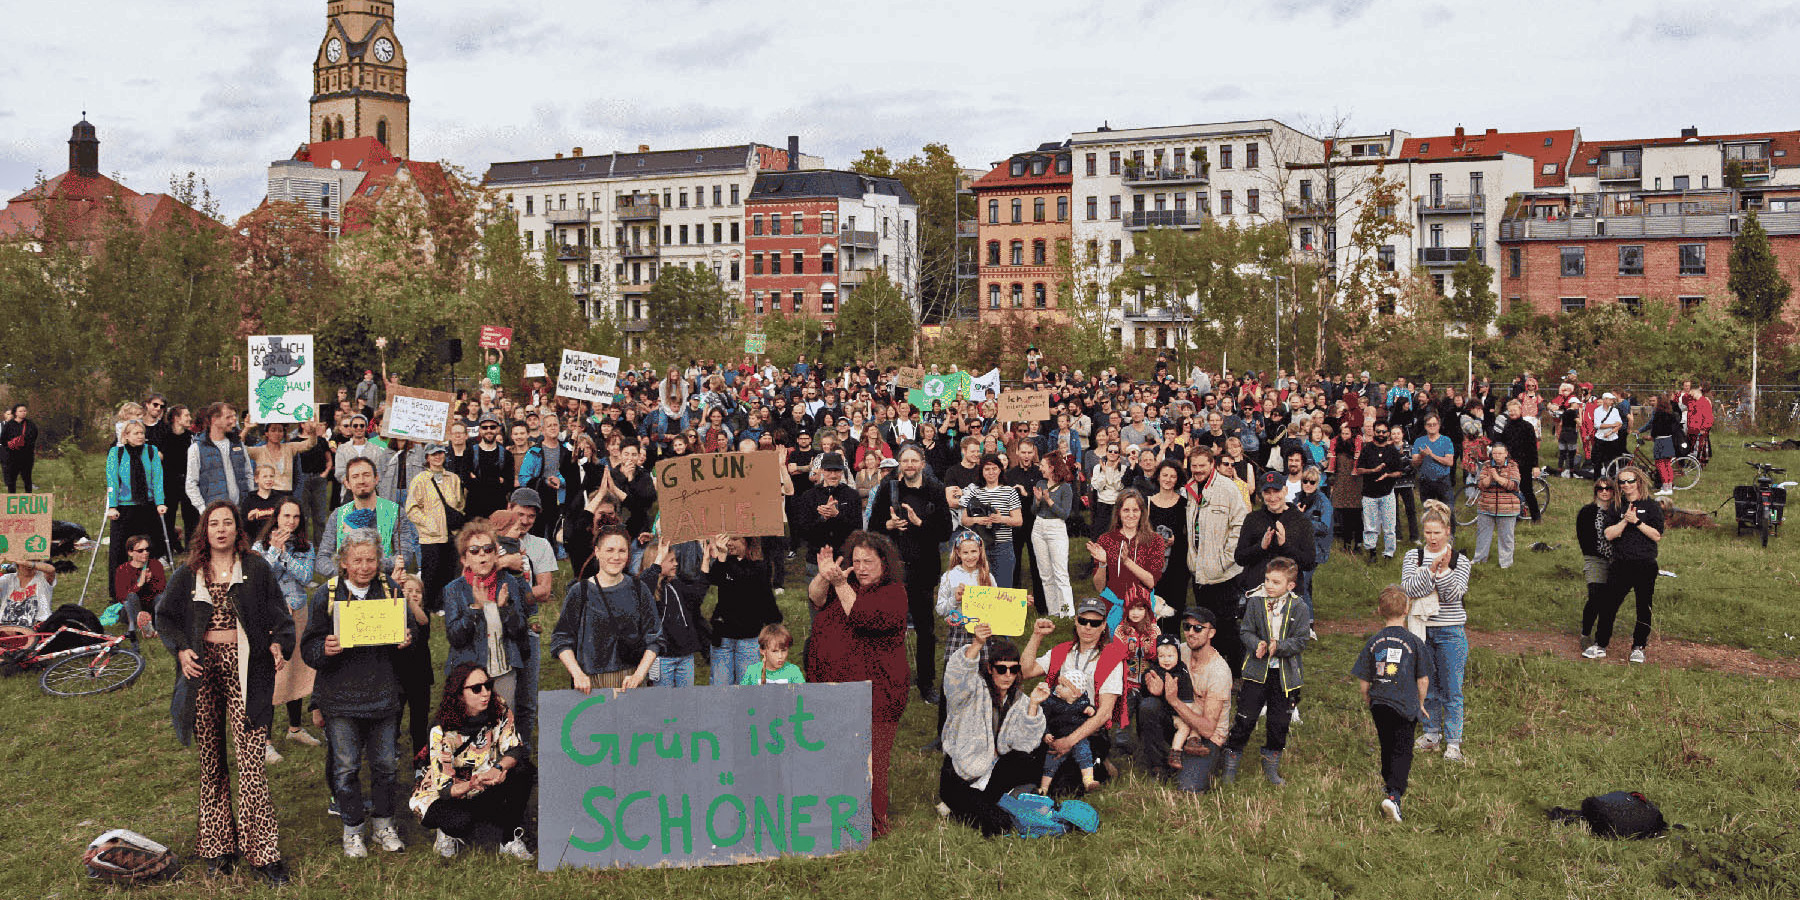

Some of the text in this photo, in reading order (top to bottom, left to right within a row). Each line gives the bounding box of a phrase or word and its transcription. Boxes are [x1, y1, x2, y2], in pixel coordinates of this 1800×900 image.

[254, 354, 291, 366] & GRAU
[565, 355, 592, 368] blühen
[563, 371, 586, 382] statt
[589, 368, 616, 379] summen
[584, 384, 614, 398] brummen
[662, 454, 745, 488] GRÜN
[560, 694, 826, 766] Grün ist
[568, 770, 864, 855] SCHÖNER
